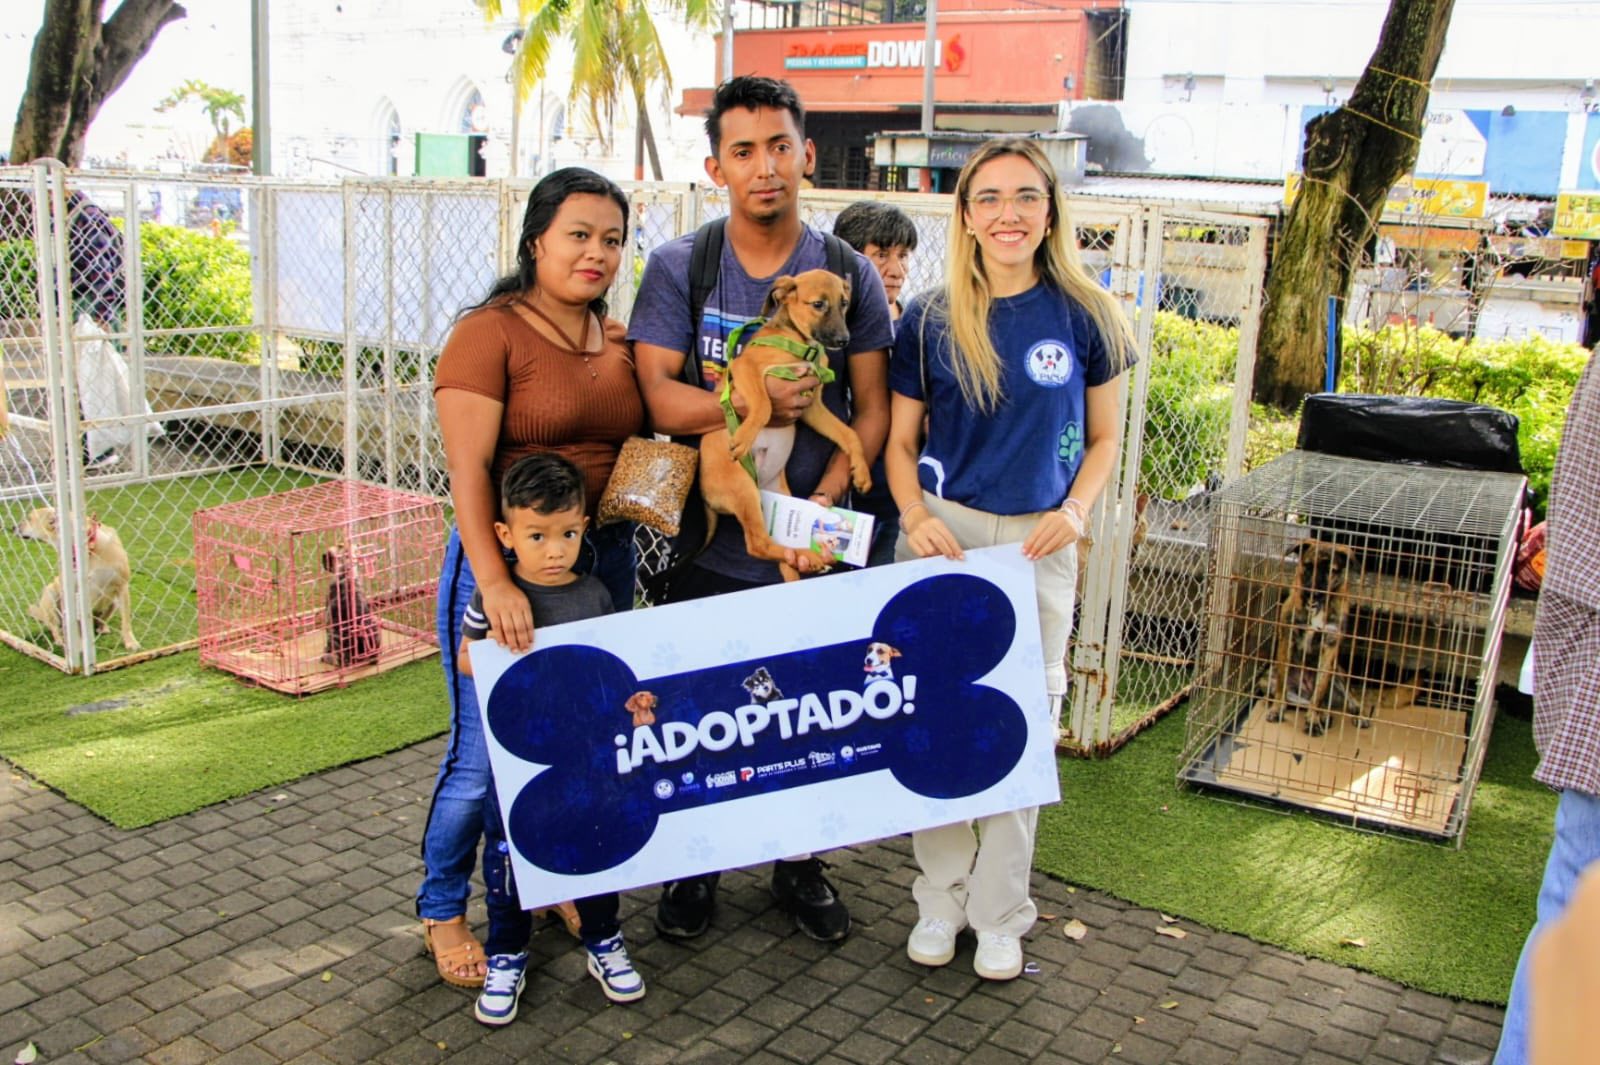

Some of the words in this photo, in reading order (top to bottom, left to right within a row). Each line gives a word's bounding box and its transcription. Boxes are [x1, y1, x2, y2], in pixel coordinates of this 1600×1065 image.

[868, 40, 941, 67] DOWN
[614, 674, 917, 774] ¡ADOPTADO!
[757, 762, 784, 774] PARTS
[784, 757, 806, 769] PLUS
